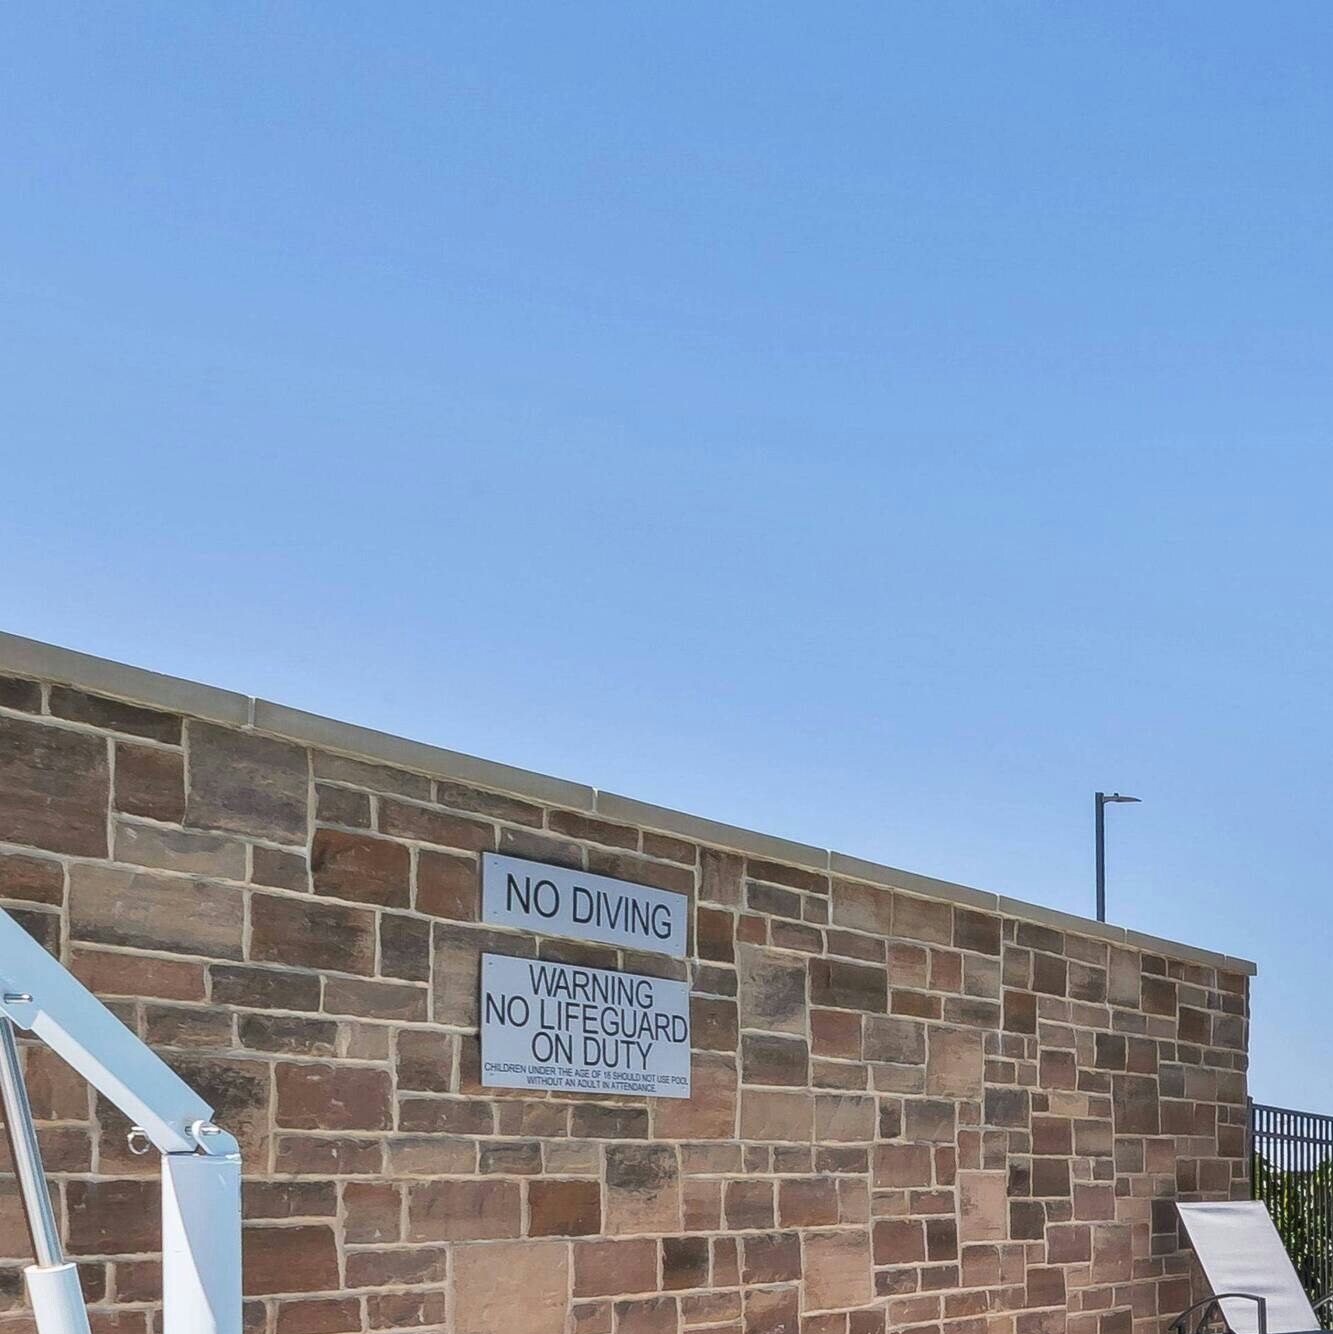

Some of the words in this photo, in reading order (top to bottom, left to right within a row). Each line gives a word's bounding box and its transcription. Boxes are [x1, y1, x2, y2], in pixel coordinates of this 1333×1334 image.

[505, 872, 561, 919] NO
[572, 885, 673, 940] DIVING
[529, 963, 654, 1010] WARNING
[485, 991, 530, 1027] NO
[540, 998, 688, 1043] LIFEGUARD
[531, 1031, 573, 1065] ON
[583, 1036, 653, 1071] DUTY
[484, 1061, 527, 1074] CHILDREN
[528, 1065, 556, 1076] UNDER
[558, 1067, 573, 1077] THE
[574, 1069, 589, 1079] AGE
[591, 1070, 601, 1079] OF
[612, 1071, 642, 1082] SHOULD
[642, 1073, 656, 1083] NOT
[656, 1075, 670, 1085] USE
[671, 1076, 689, 1086] POOL
[526, 1076, 563, 1087] WITHOUT
[565, 1078, 576, 1087] AN
[576, 1079, 600, 1089] ADULT
[602, 1081, 610, 1089] IN
[612, 1081, 657, 1093] ATTENDANCE
